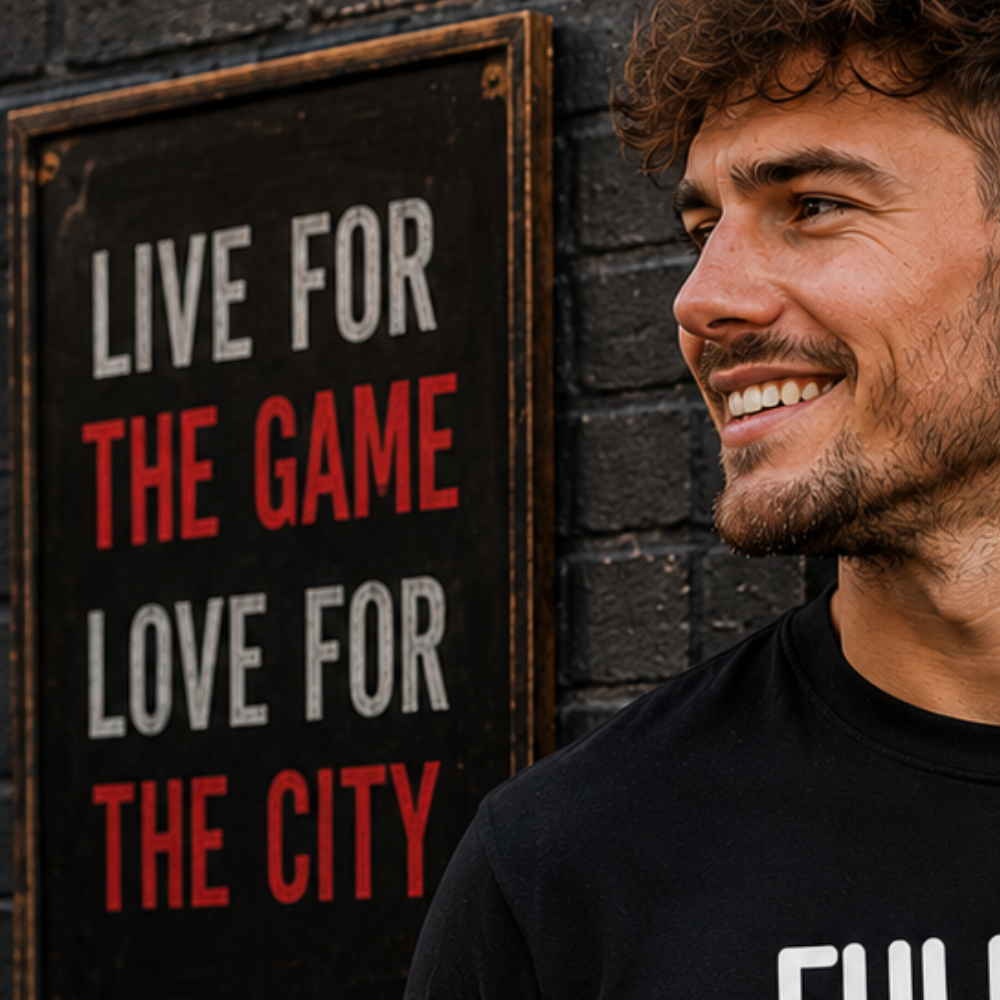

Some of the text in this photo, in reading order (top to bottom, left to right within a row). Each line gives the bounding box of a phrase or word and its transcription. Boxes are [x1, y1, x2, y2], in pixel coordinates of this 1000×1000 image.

[92, 197, 437, 379] LIVE FOR
[82, 372, 460, 549] THE GAME
[87, 576, 449, 739] LOVE FOR
[92, 761, 441, 912] THE CITY
